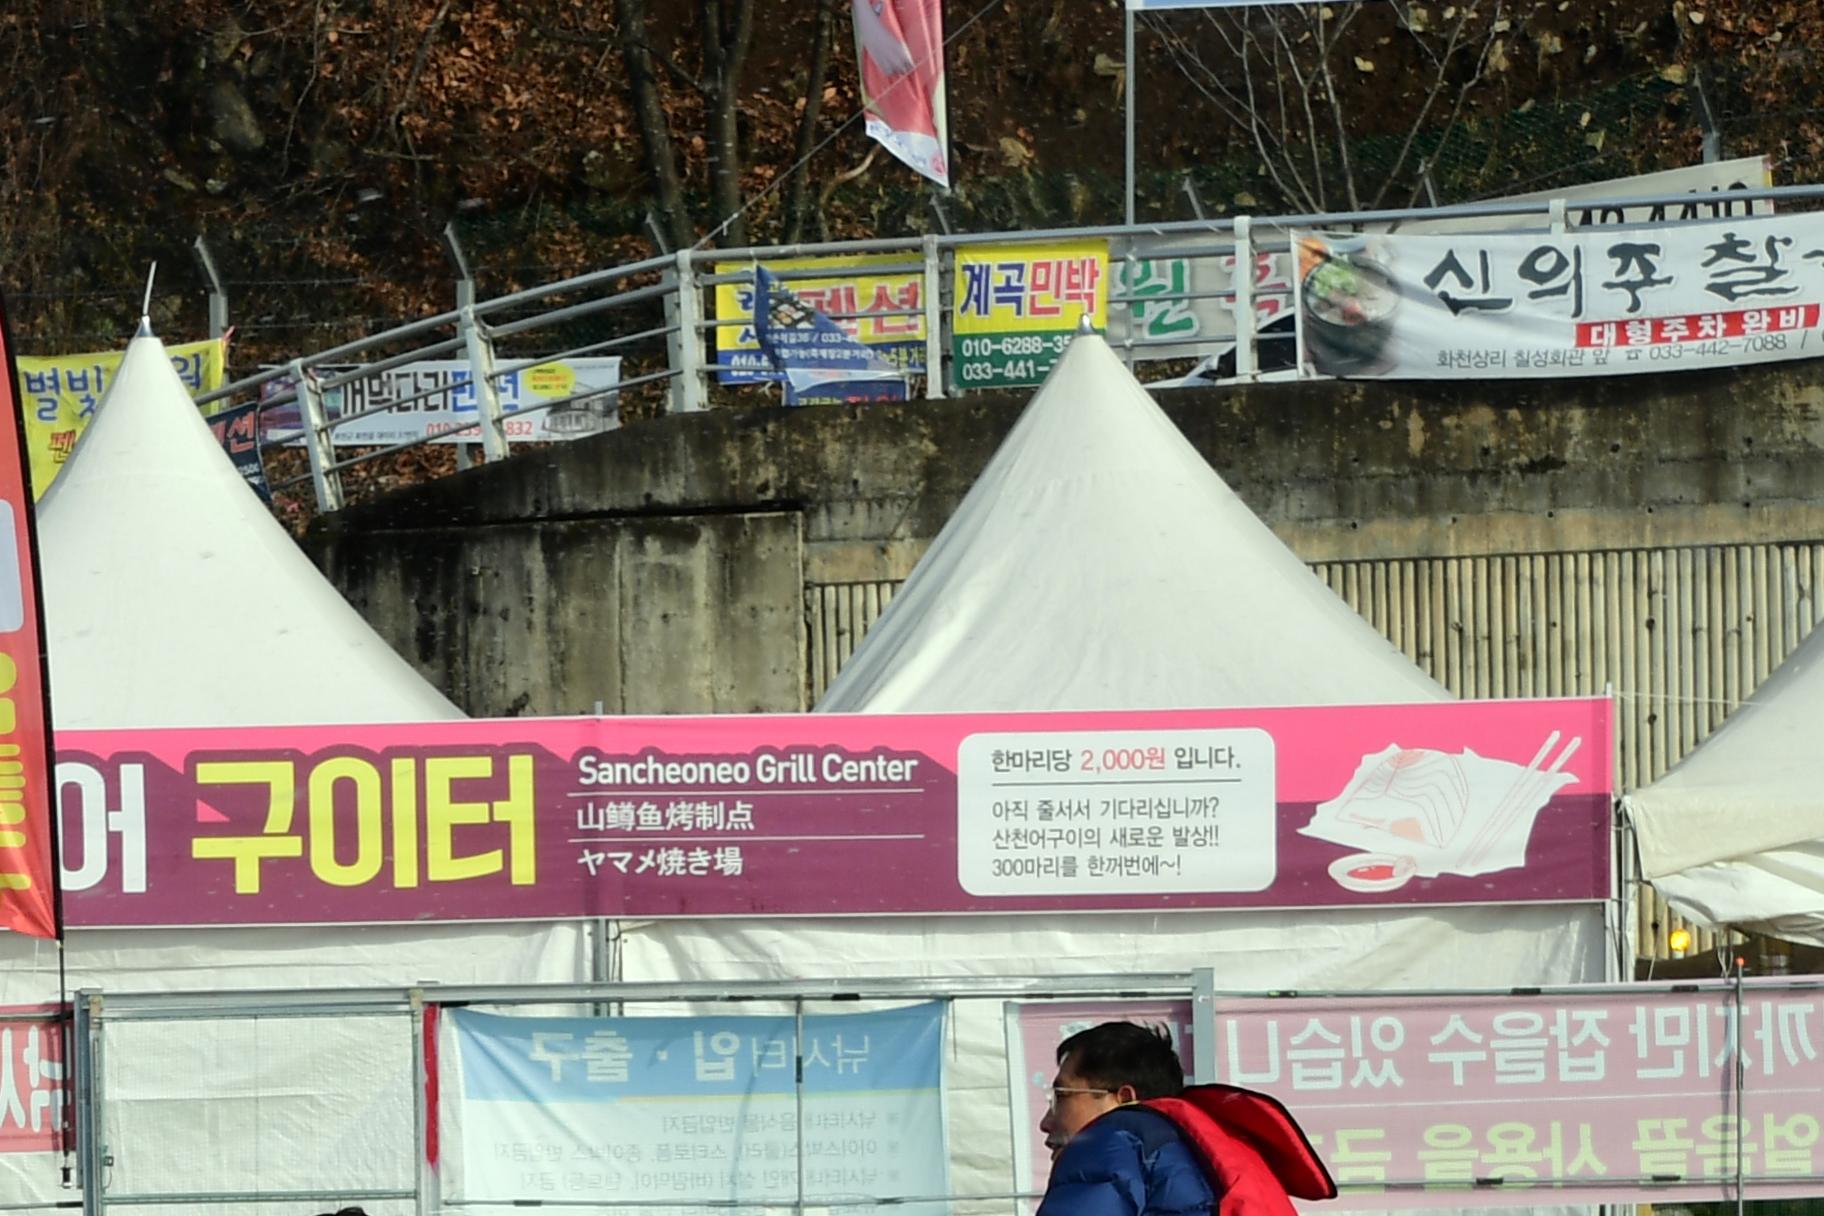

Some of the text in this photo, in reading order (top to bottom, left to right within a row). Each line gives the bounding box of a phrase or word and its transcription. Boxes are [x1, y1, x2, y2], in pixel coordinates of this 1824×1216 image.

[1700, 232, 1824, 302] 찰
[960, 256, 1102, 319] 계곡민박
[1589, 305, 1807, 348] 대형주차 완비
[961, 334, 1073, 358] 010-6288-35
[1649, 334, 1788, 361] 033-442-7088
[578, 752, 919, 785] Sancheoneo Grill Center
[991, 745, 1242, 774] 한마리당 2,000원 입니다.
[991, 795, 1220, 822] 아직 줄서서 기다리십니까?
[191, 754, 536, 895] 구이터
[991, 824, 1220, 851] 산천어구이의 새로운 발상!!
[576, 846, 745, 877] ヤマメ焼き場
[991, 855, 1079, 878] 300마리를
